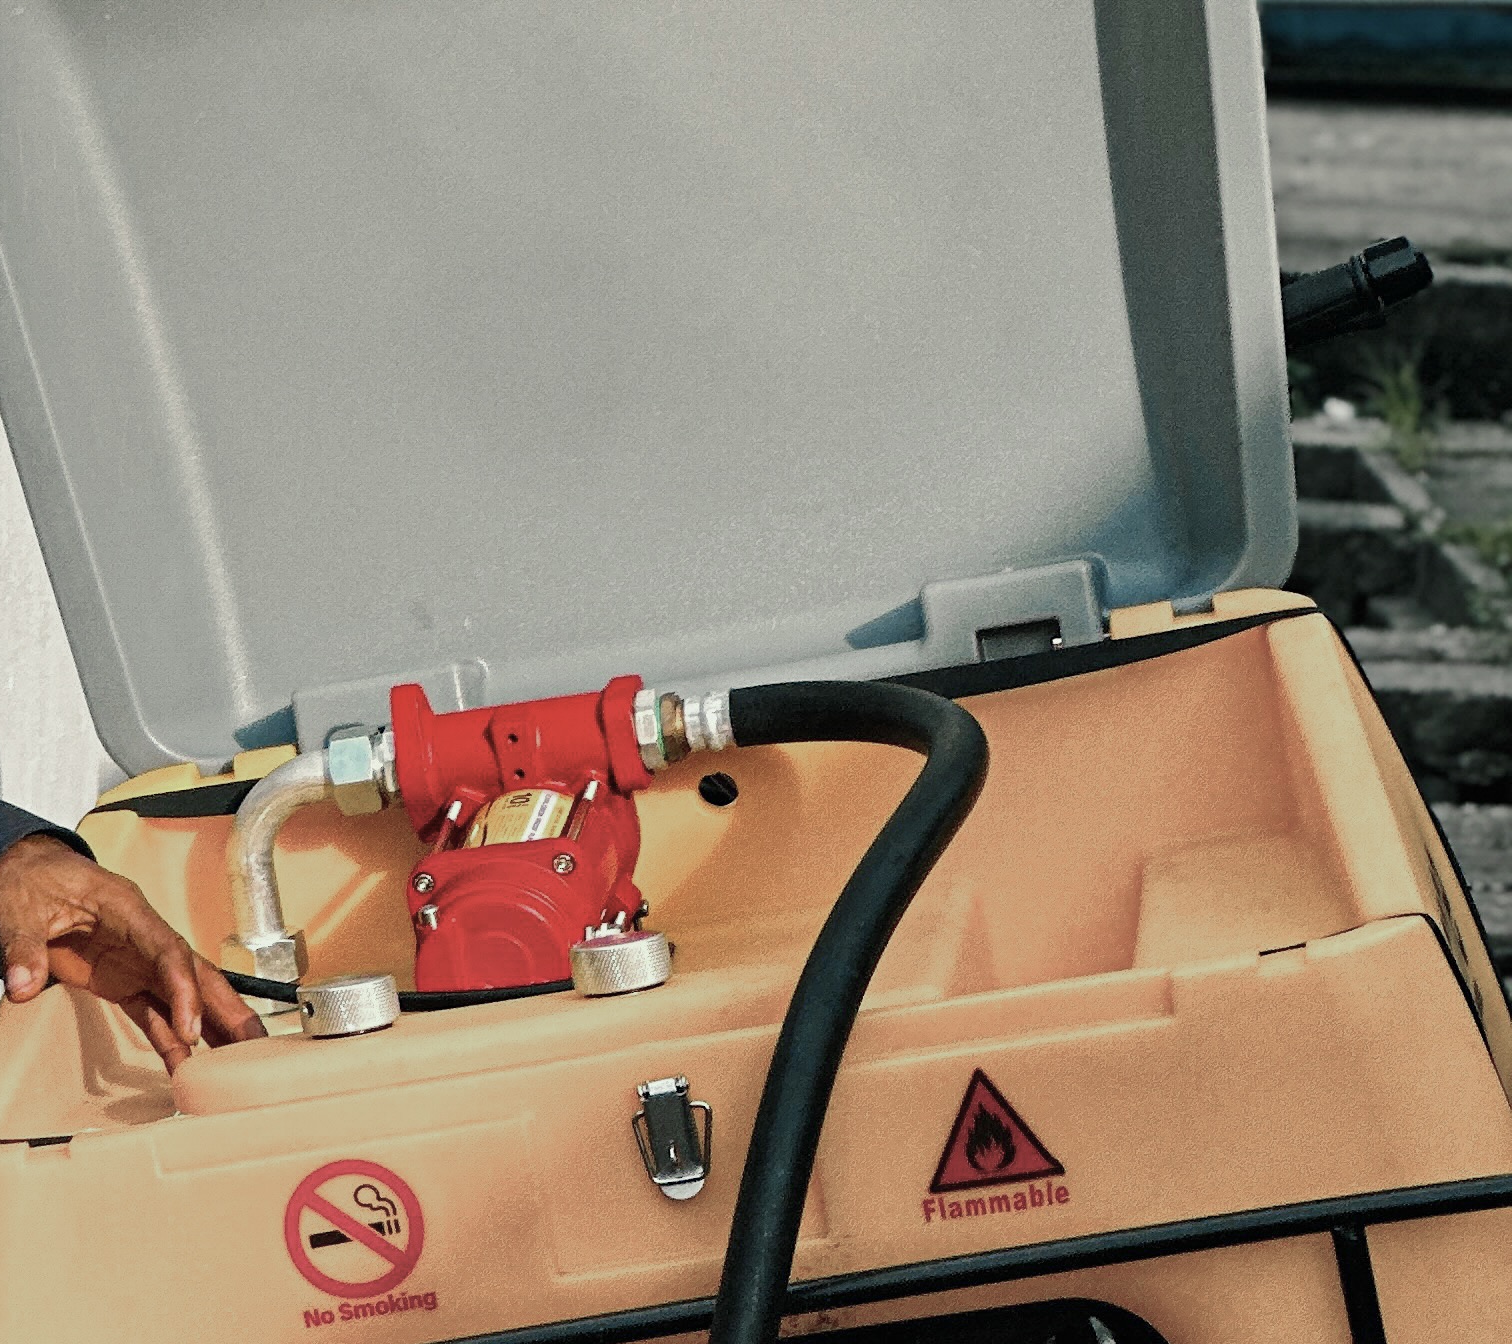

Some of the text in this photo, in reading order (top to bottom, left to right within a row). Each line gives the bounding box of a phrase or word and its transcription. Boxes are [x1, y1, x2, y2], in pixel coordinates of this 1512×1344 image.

[922, 1180, 1071, 1223] Flammable
[302, 1290, 439, 1329] No Smoking
